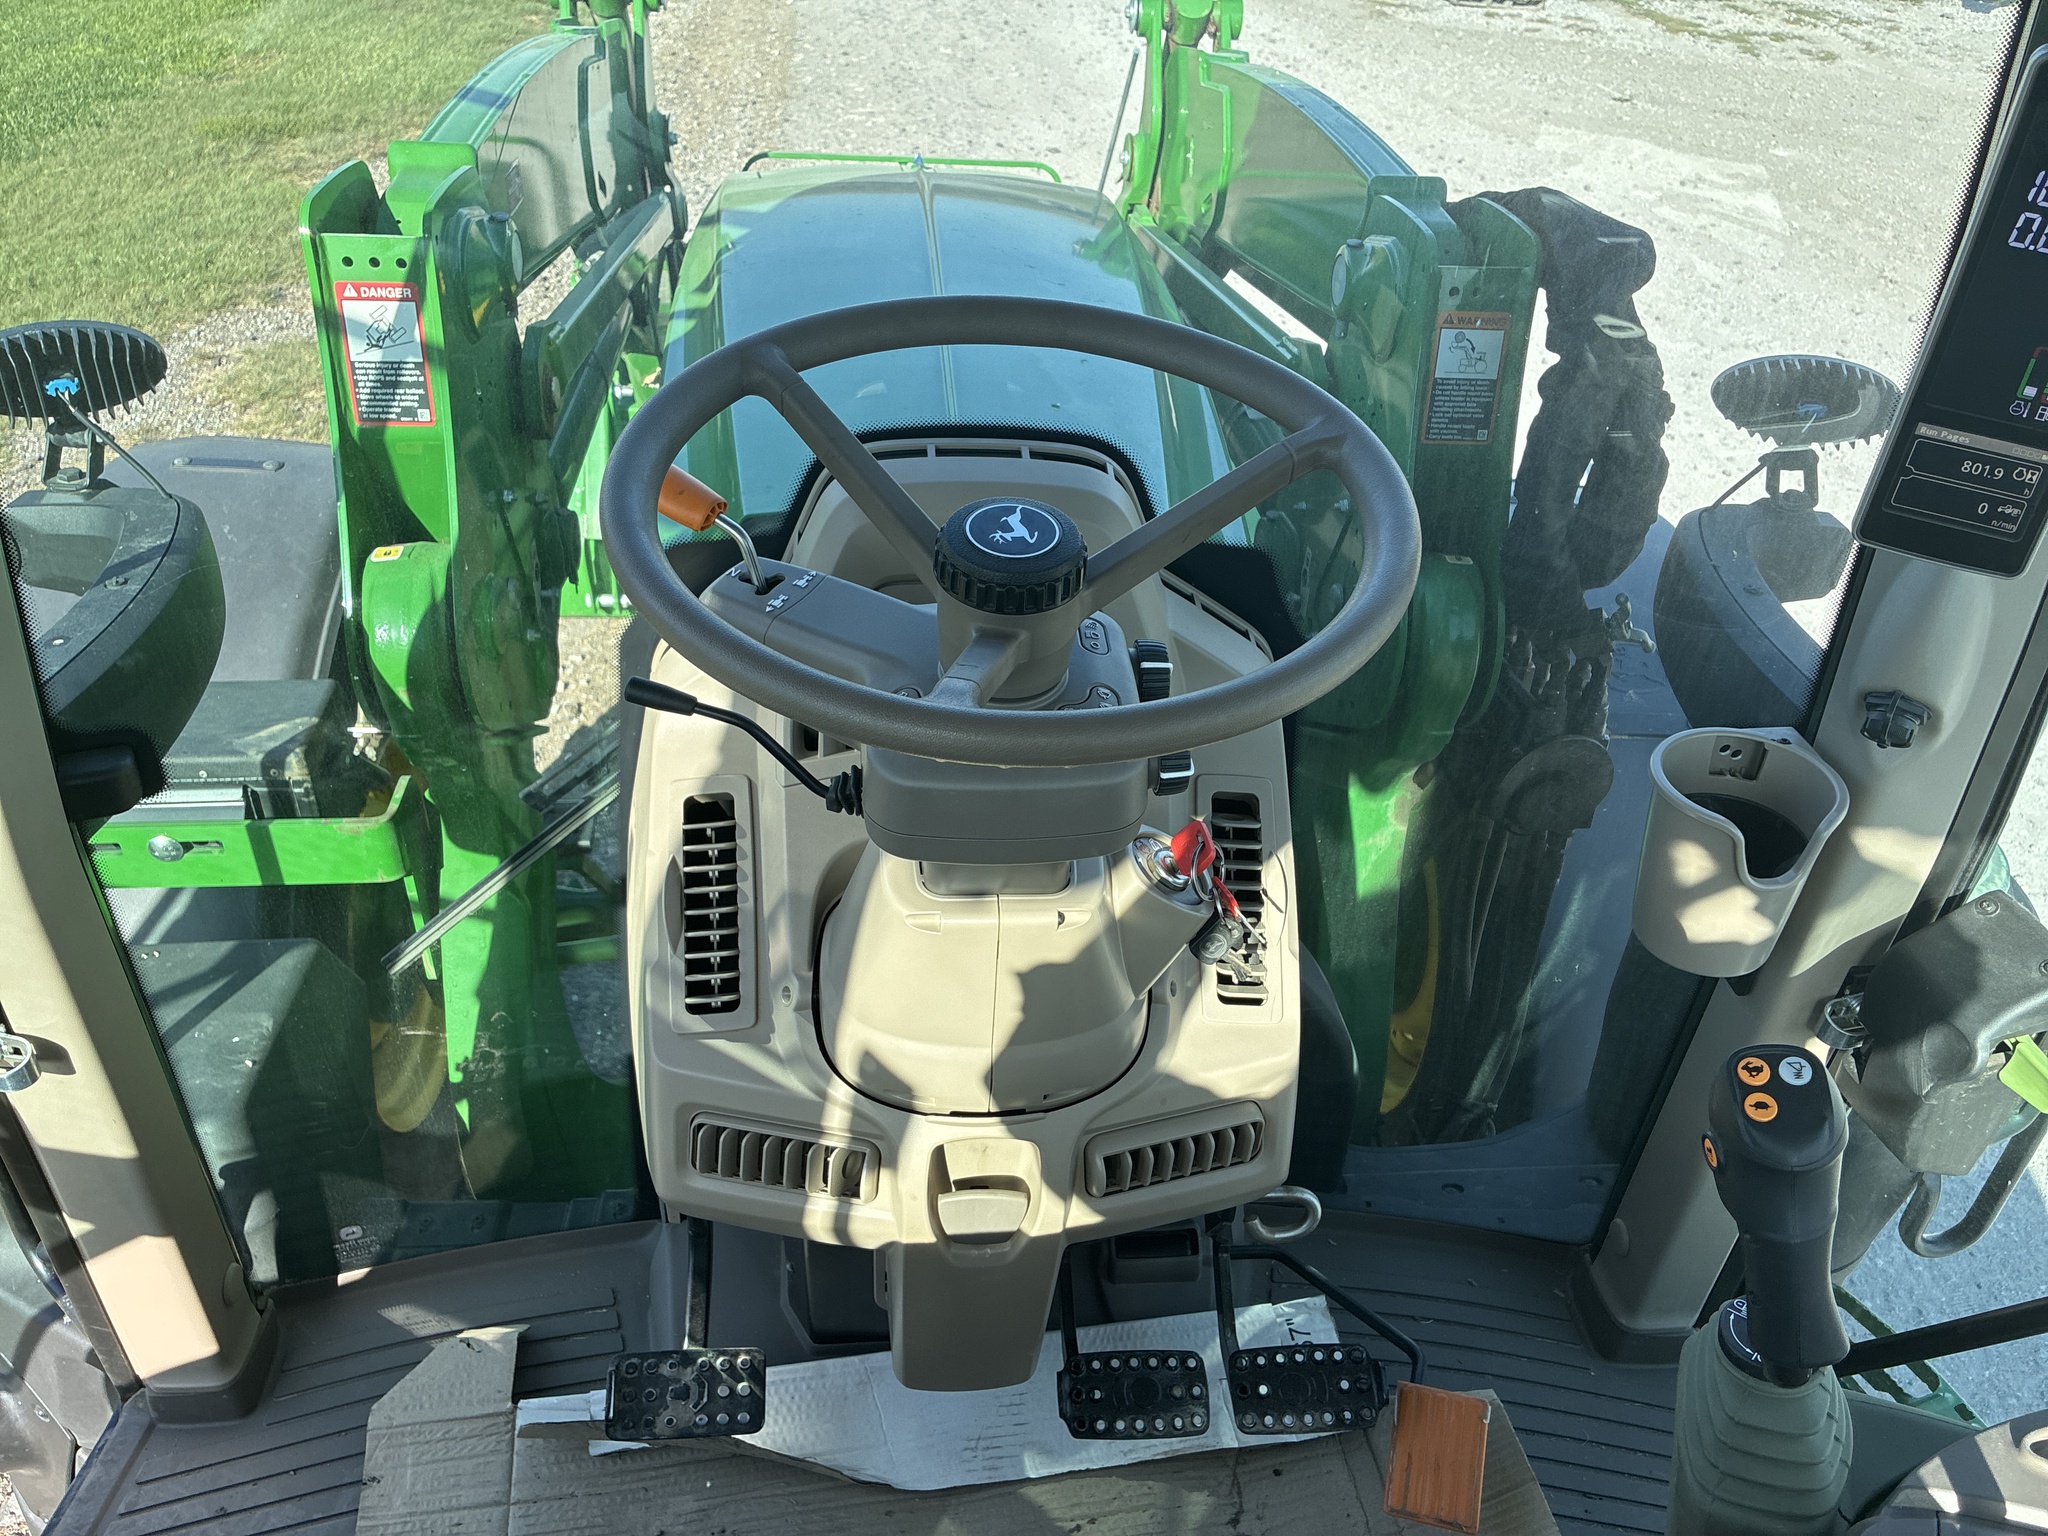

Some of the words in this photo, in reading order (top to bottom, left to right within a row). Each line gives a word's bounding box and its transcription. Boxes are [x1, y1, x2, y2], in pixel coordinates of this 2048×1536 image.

[360, 287, 412, 298] DANGER
[1457, 316, 1506, 326] WARNING
[1919, 426, 1938, 436] Run
[1941, 431, 1971, 444] Pages
[1961, 461, 2004, 480] 801.9
[2023, 488, 2030, 496] h
[1978, 503, 1988, 515] 0
[1991, 520, 2016, 531] n/min
